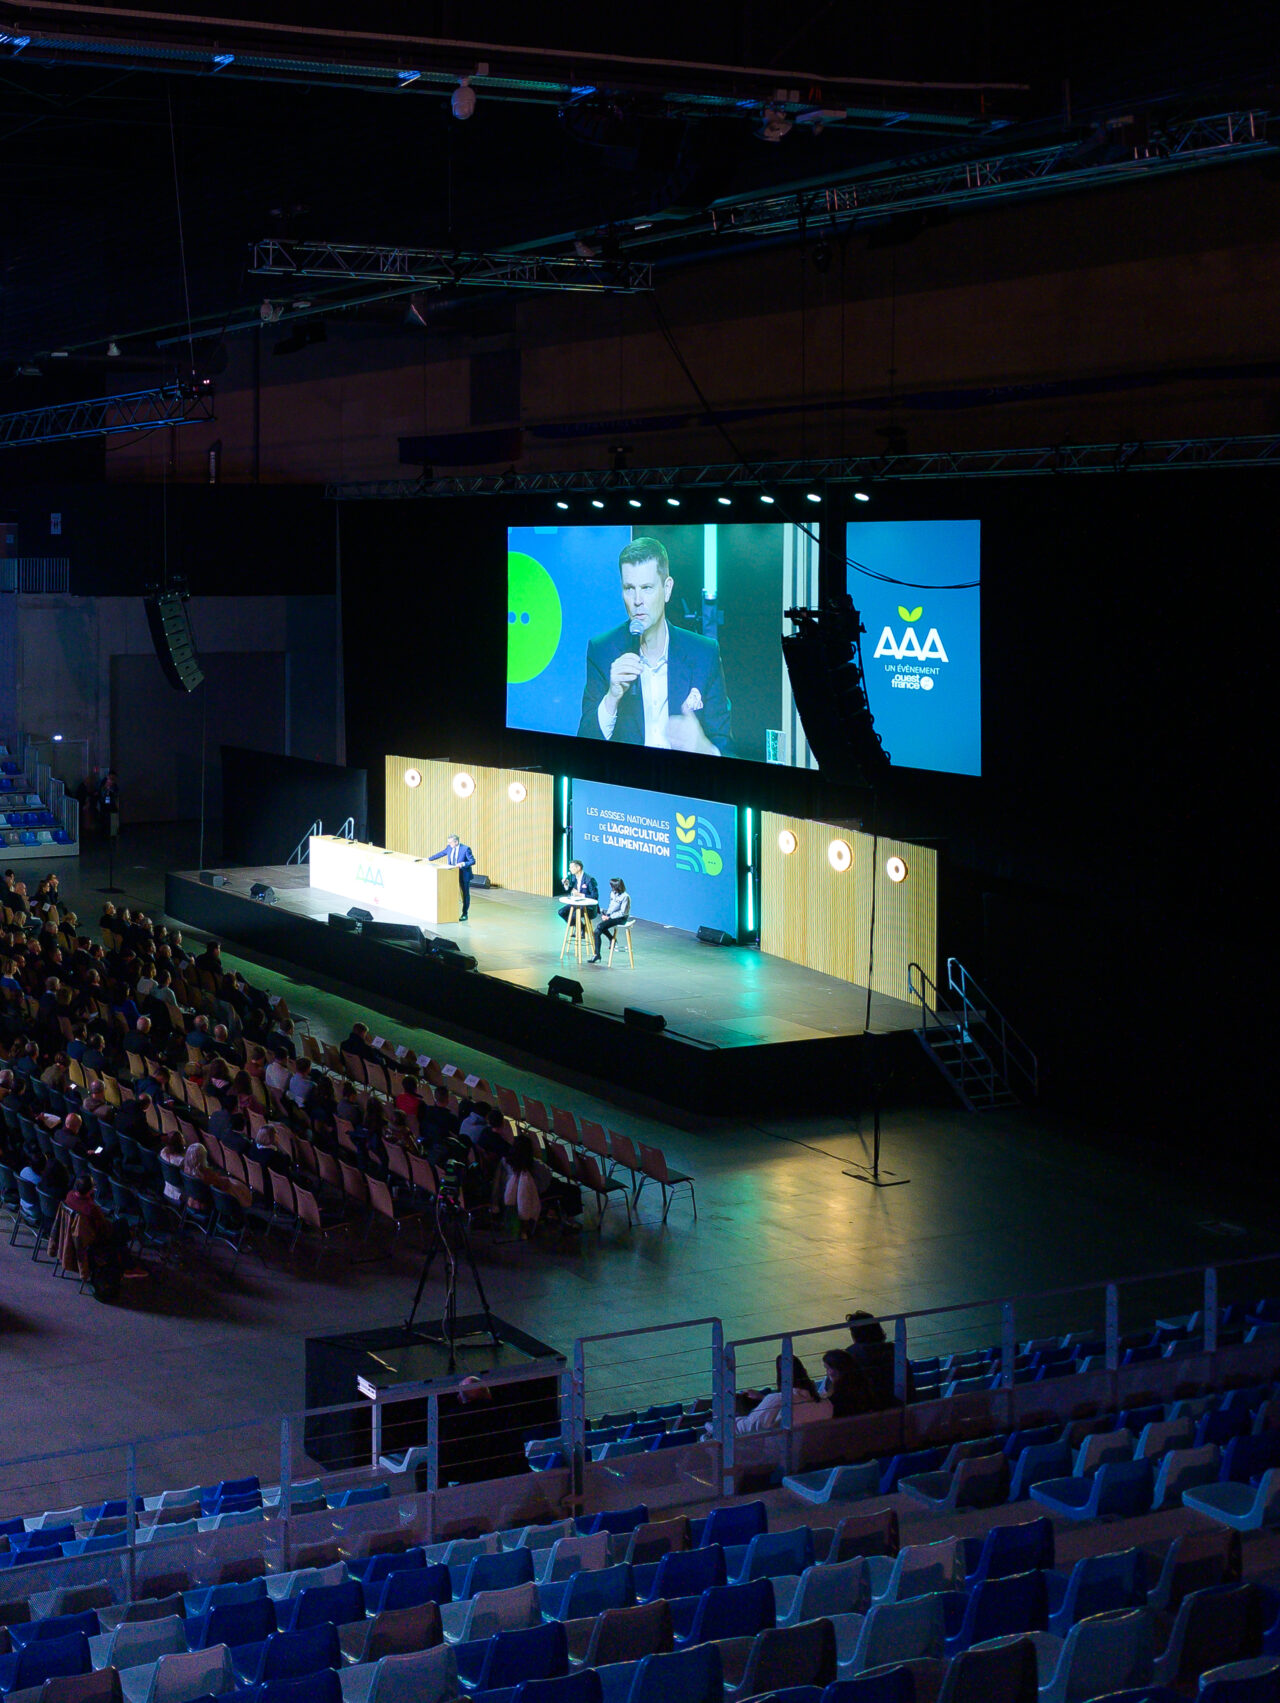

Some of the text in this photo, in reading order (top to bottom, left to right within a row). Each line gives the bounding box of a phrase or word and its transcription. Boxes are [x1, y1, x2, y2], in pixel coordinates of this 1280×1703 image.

[873, 626, 949, 663] AAA
[884, 664, 896, 672] UN
[895, 674, 920, 683] ouest
[891, 678, 920, 690] france
[586, 807, 670, 830] LES ASSISES NATIONALES
[599, 822, 670, 843] DE L'AGRICULTURE
[584, 832, 670, 856] ET DE L'ALIMENTATION
